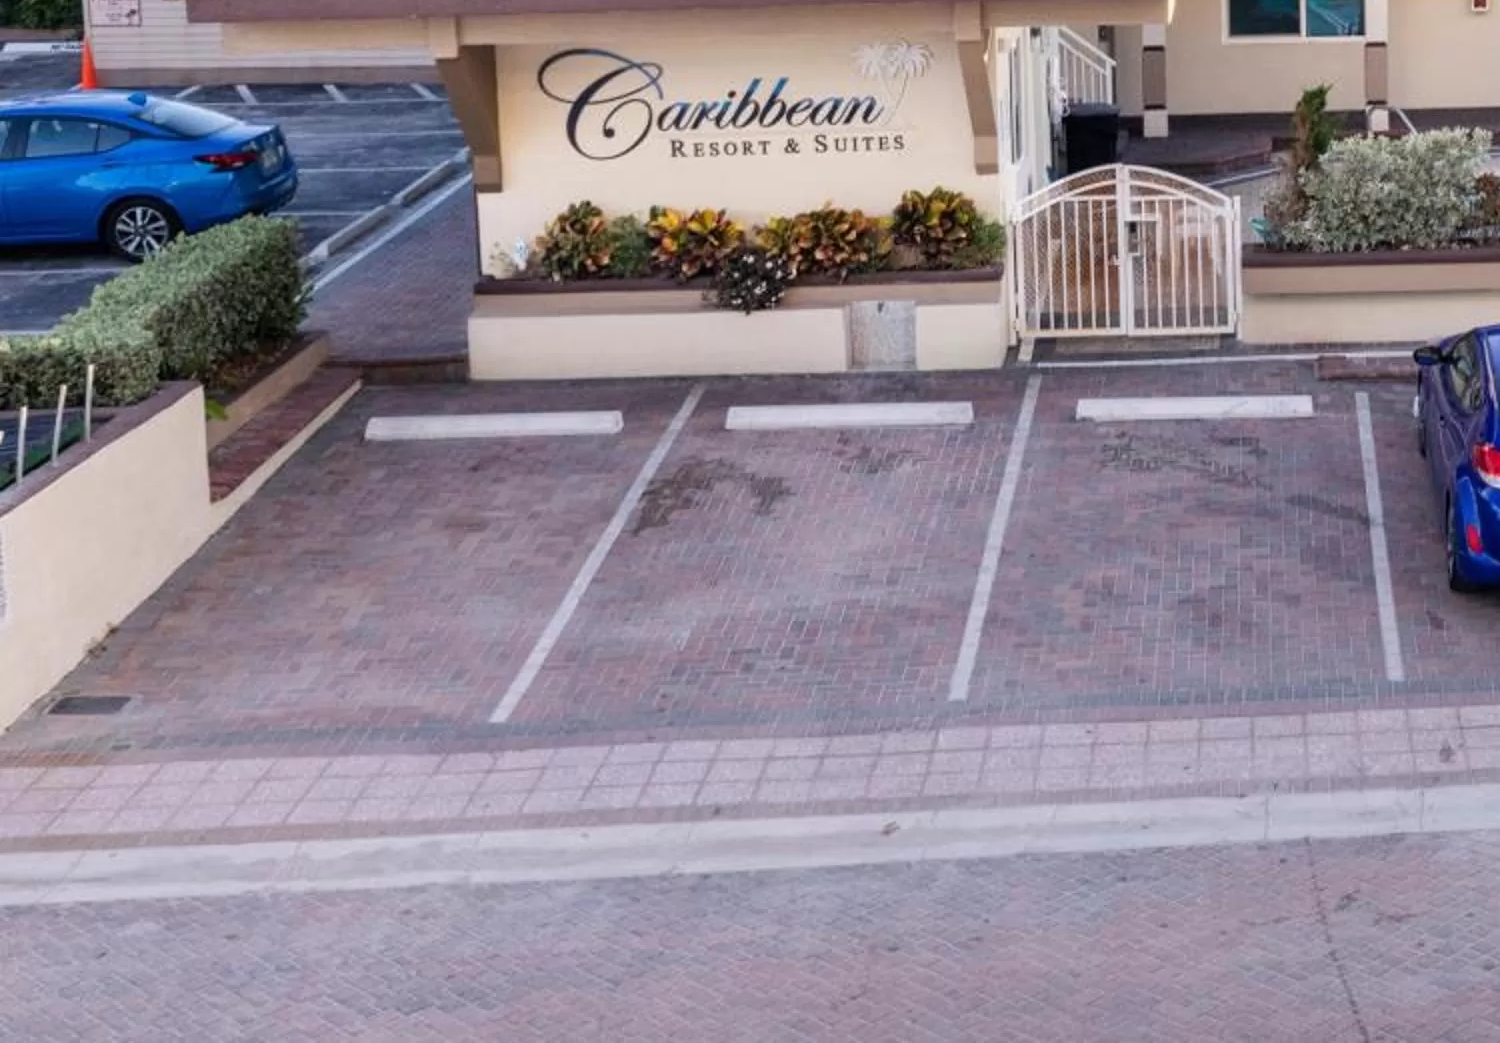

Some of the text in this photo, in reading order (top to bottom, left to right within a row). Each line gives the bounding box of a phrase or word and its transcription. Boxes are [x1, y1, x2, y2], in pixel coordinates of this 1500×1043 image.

[537, 48, 884, 160] Caribbean
[670, 133, 906, 158] RESORT & SUITES
